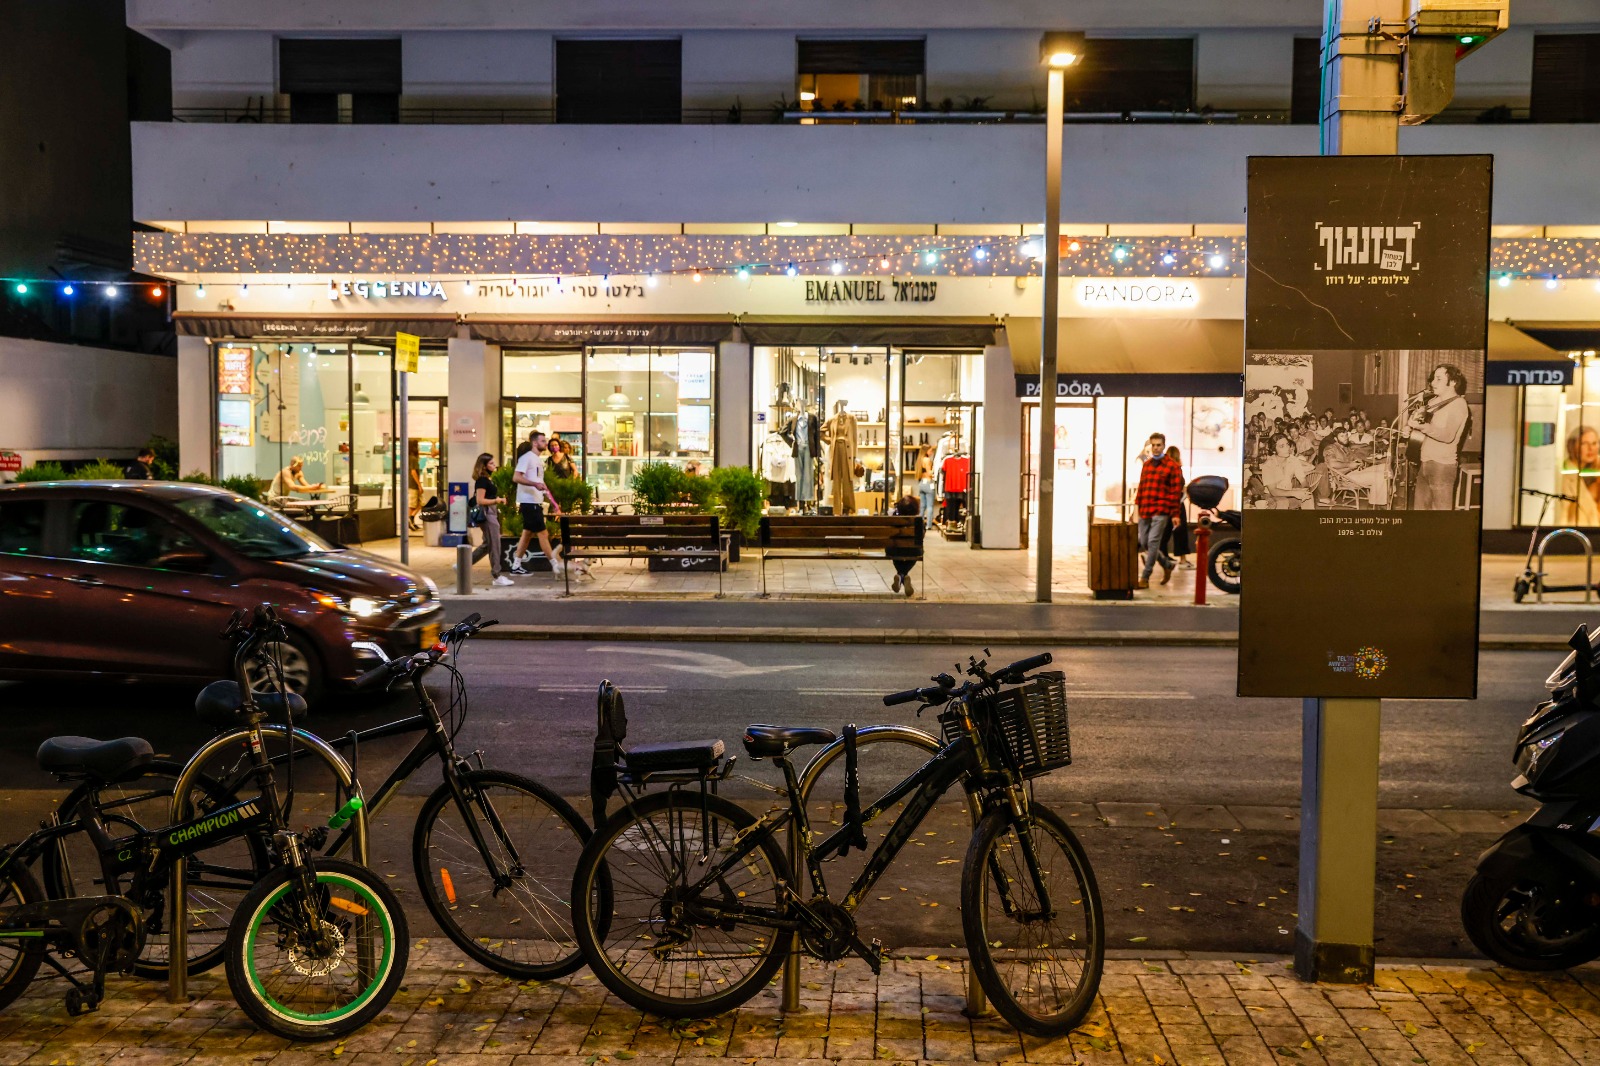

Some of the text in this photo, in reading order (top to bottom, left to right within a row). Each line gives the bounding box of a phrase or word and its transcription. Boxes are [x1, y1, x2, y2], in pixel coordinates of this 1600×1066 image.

[1319, 226, 1415, 270] דיזנגוף
[1325, 274, 1410, 286] צילומים: יעל רוזן
[327, 278, 448, 300] LEGGENDA
[572, 285, 598, 298] טרי
[804, 280, 885, 301] EMANUEL
[892, 276, 938, 302] עמנואל
[1084, 285, 1194, 301] PANDORA
[1507, 369, 1565, 385] פנדורה
[1026, 380, 1104, 396] PADORA
[169, 809, 239, 845] CHAMPION
[118, 849, 133, 862] C2
